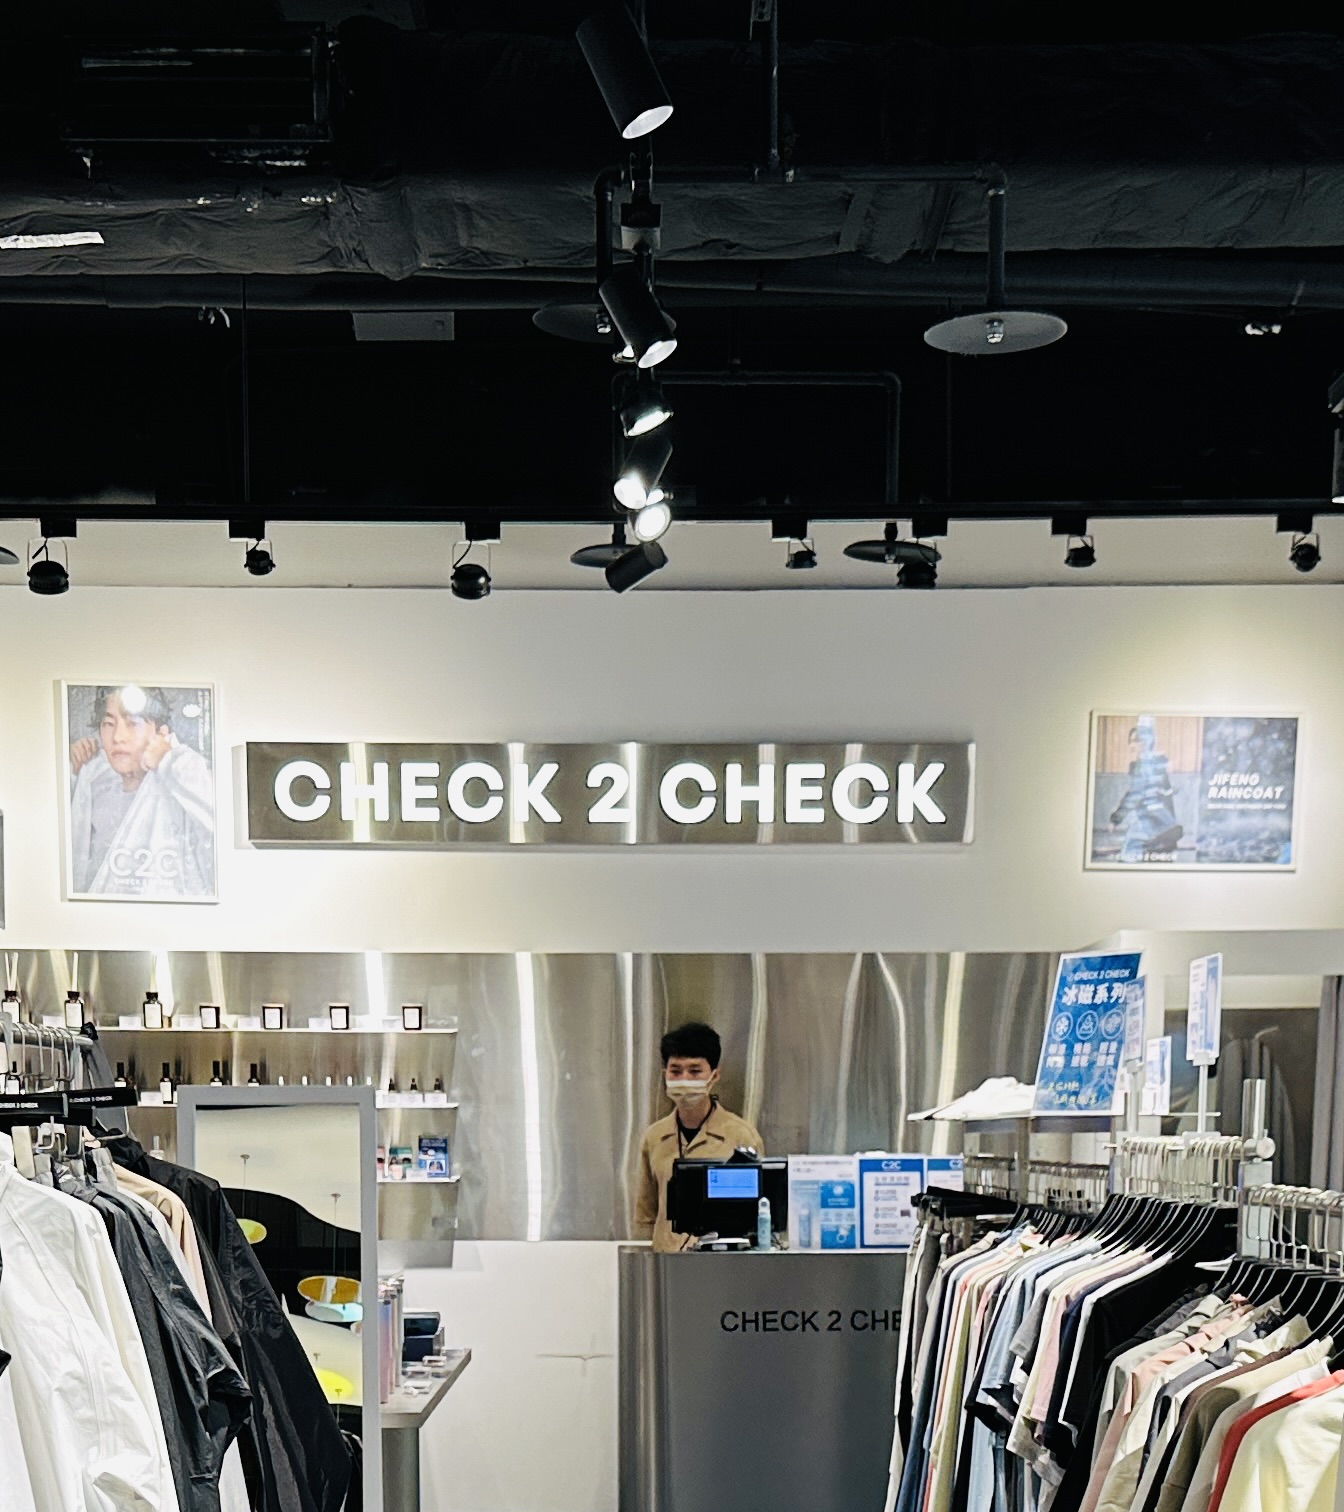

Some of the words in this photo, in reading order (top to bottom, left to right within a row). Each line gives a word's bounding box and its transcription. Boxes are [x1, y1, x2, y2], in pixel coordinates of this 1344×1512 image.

[273, 761, 562, 824] CHECK
[586, 762, 632, 823] 2
[659, 761, 947, 824] CHECK
[1207, 786, 1284, 799] RAINCOAT
[109, 848, 177, 878] C2C
[720, 1310, 820, 1332] CHECK
[826, 1310, 842, 1332] 2
[850, 1309, 903, 1332] CHE
